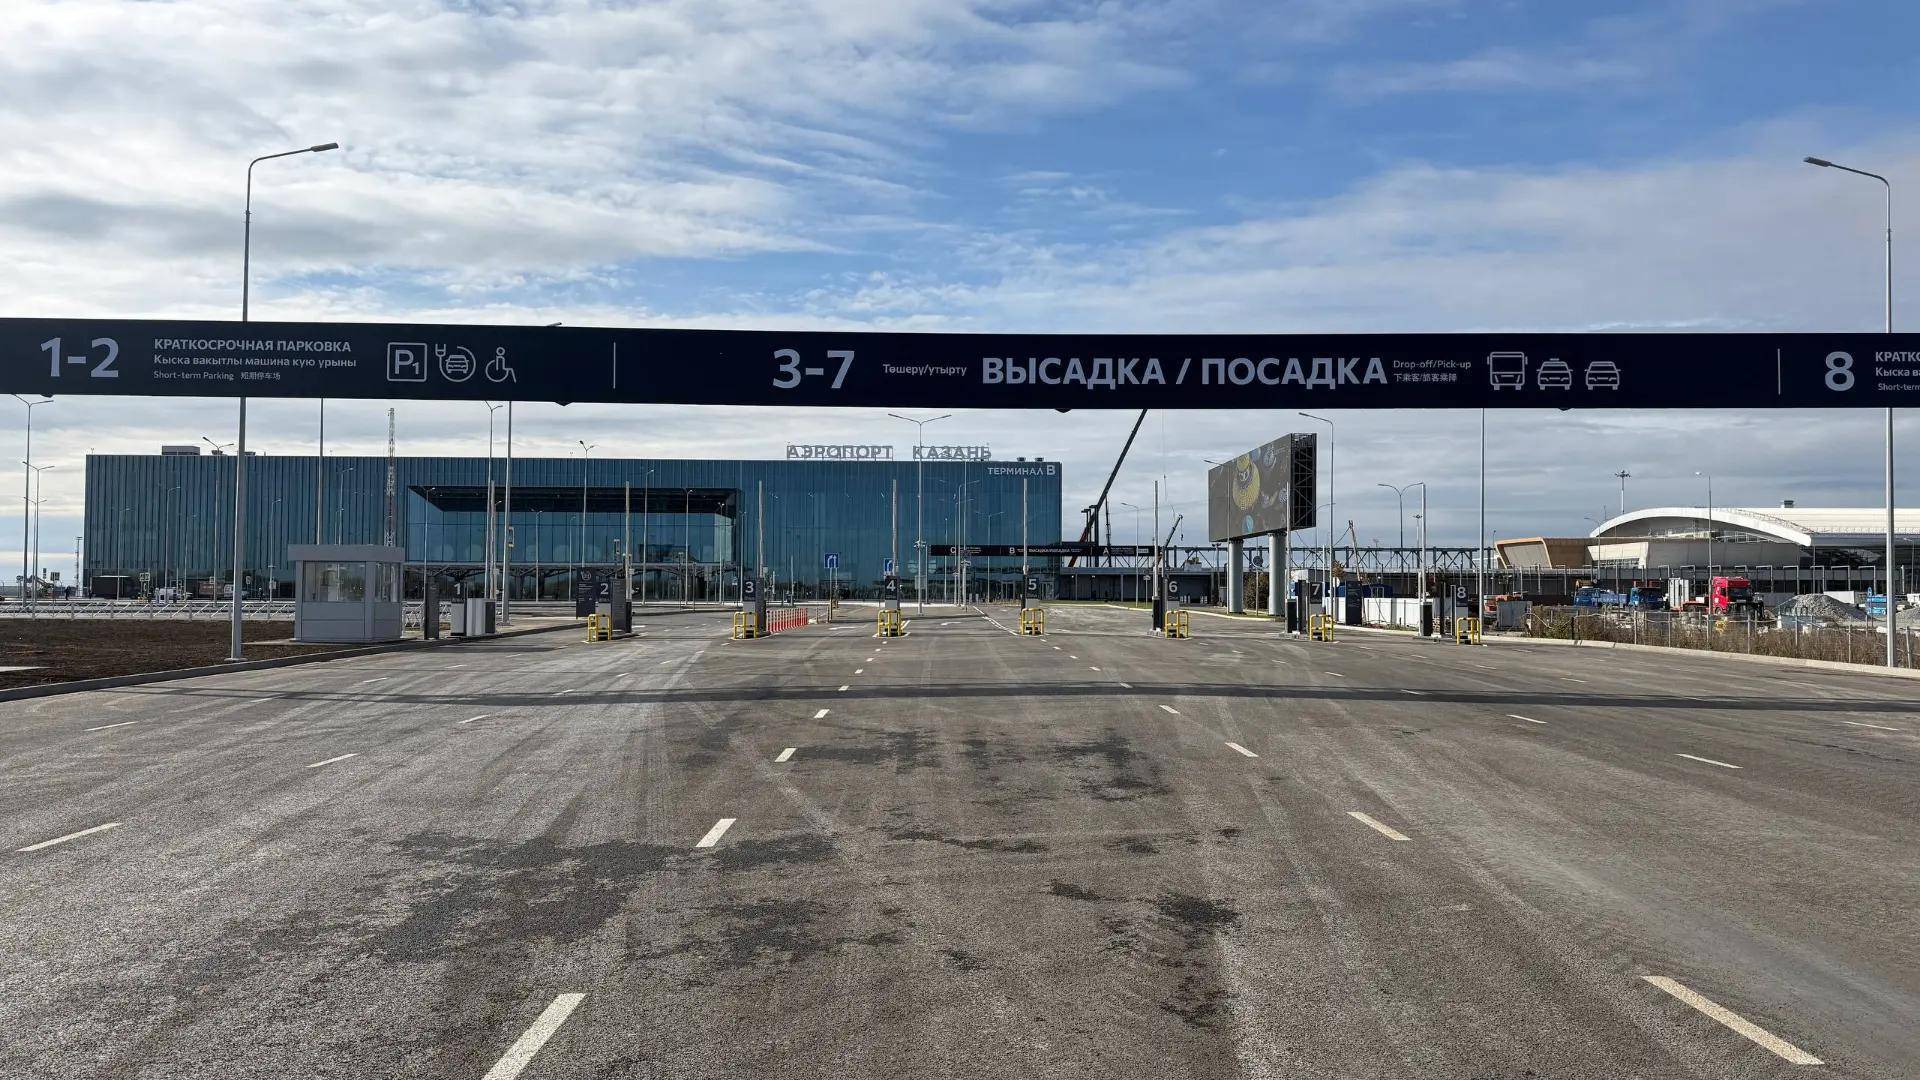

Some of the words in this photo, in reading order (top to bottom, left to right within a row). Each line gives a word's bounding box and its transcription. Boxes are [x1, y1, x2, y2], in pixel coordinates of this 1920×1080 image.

[154, 338, 274, 352] КРАТКОСРОЧНАЯ
[277, 340, 352, 353] ПАРКОВКА
[41, 337, 119, 378] 1-2
[154, 354, 190, 366] Кыска
[193, 356, 244, 366] вакытлы
[246, 357, 290, 367] машина
[293, 358, 316, 369] кую
[318, 358, 356, 369] урыны
[772, 348, 855, 389] 3-7
[1393, 359, 1472, 370] Drop-off/Pick-up
[153, 371, 201, 380] Short-term
[203, 371, 234, 381] Parking
[982, 357, 1166, 390] ВЫСАДКА
[1175, 358, 1192, 385] /
[1201, 357, 1388, 390] ПОСАДКА
[1824, 351, 1855, 392] 8
[1875, 367, 1910, 377] Кыска
[787, 445, 893, 459] АЭРОПОРТ
[912, 446, 992, 459] КАЗАНЬ
[987, 467, 1044, 476] ТЕРМИНАЛ
[453, 583, 461, 595] 1
[600, 583, 609, 595] 2
[745, 581, 754, 593] 3
[886, 579, 896, 591] 4
[1028, 578, 1037, 591] 5
[1168, 581, 1178, 593] 6
[1311, 583, 1321, 595] 7
[1457, 586, 1466, 599] 8
